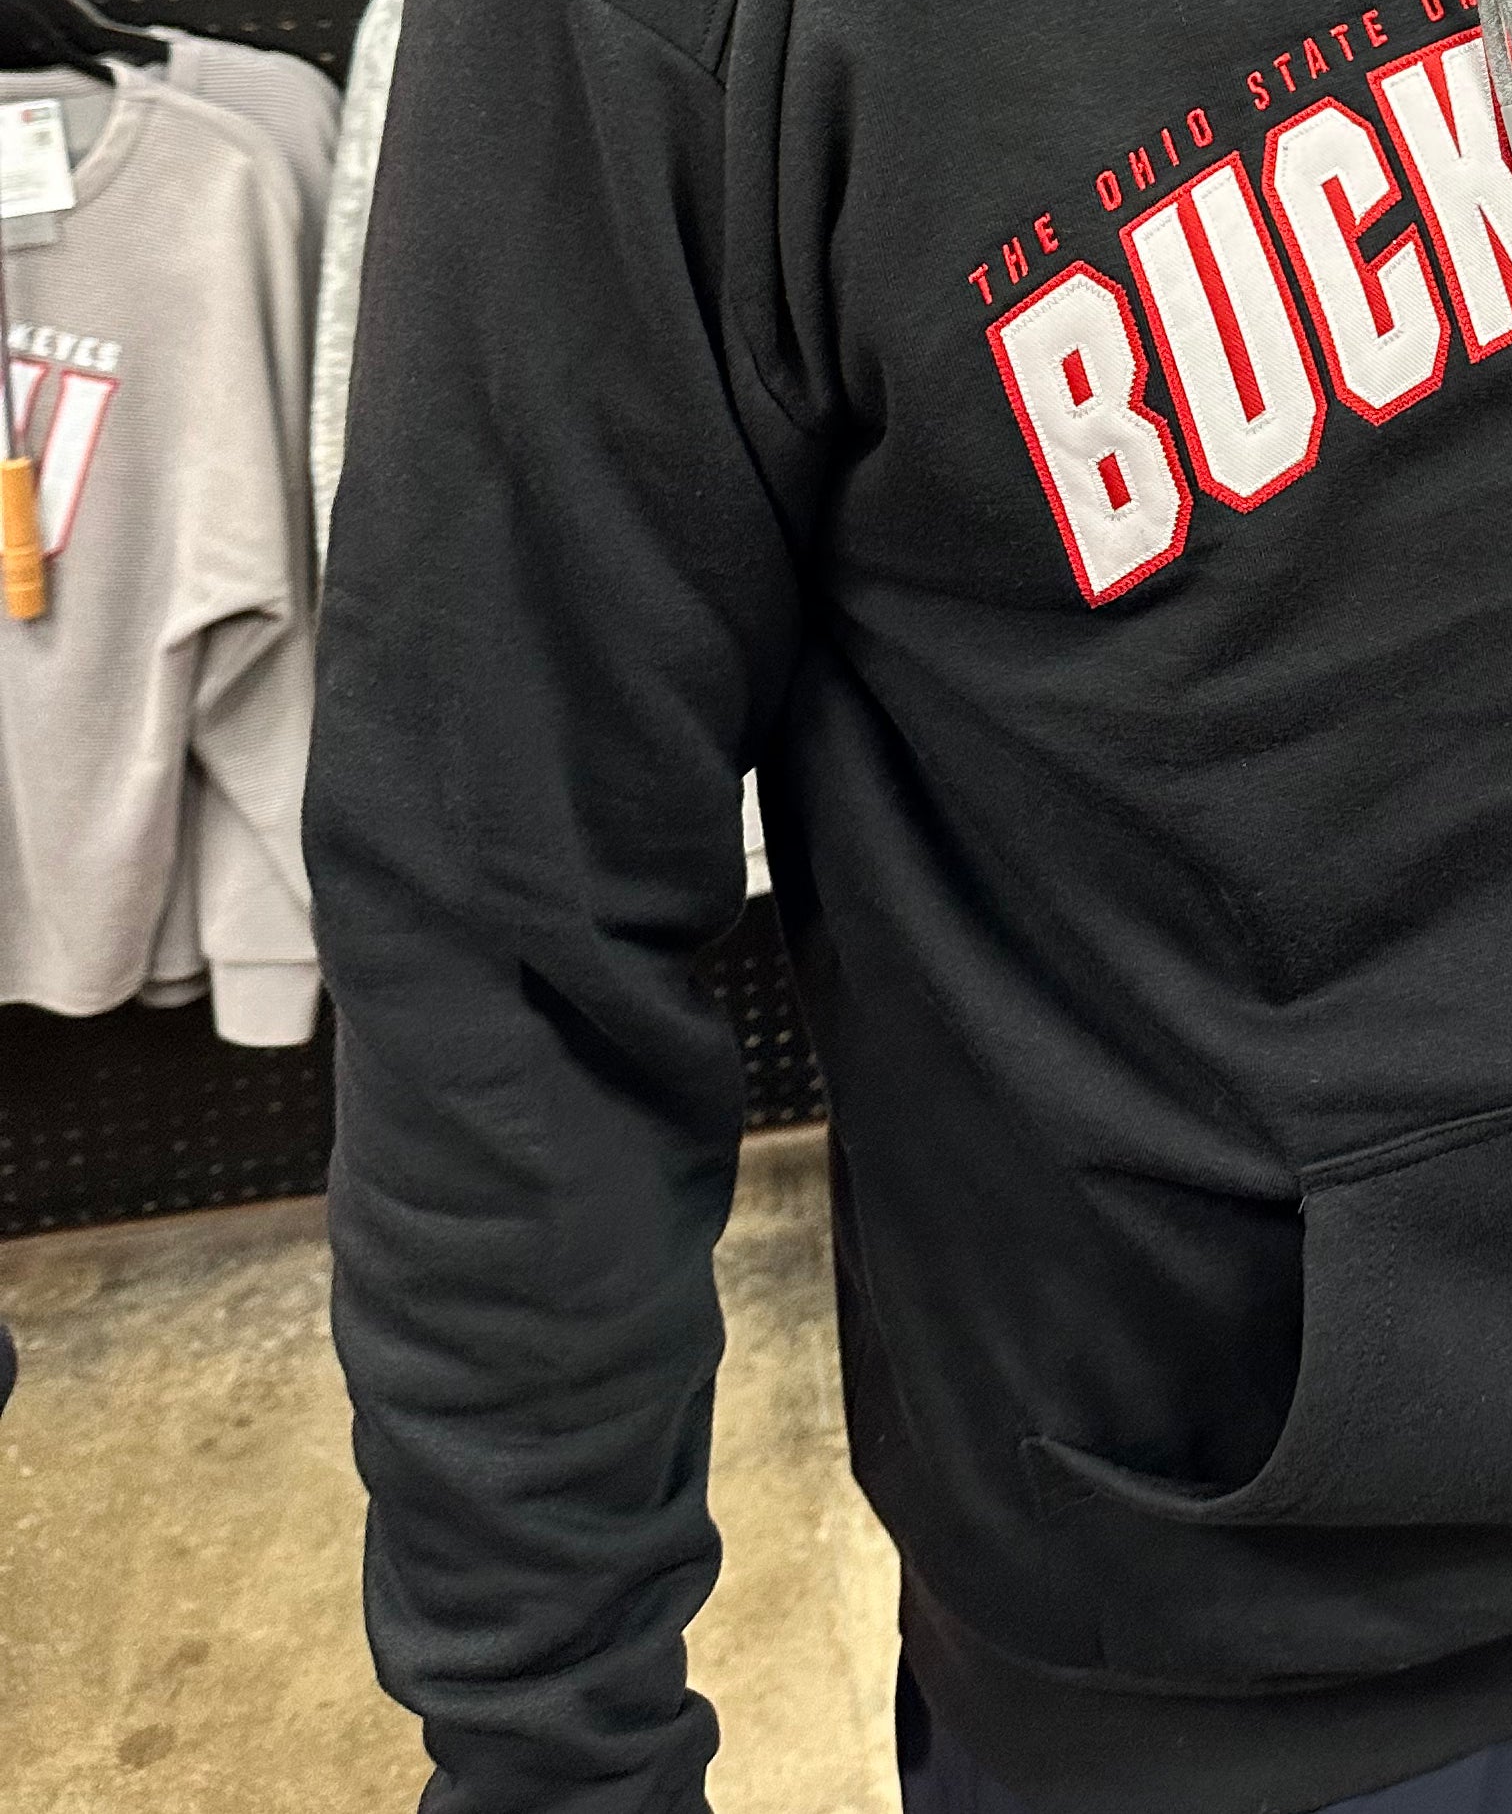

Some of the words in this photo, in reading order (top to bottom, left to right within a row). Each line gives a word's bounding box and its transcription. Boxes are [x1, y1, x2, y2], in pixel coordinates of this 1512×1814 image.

[967, 210, 1060, 306] THE
[1096, 106, 1215, 212] OHIO
[1246, 8, 1389, 112] STATE
